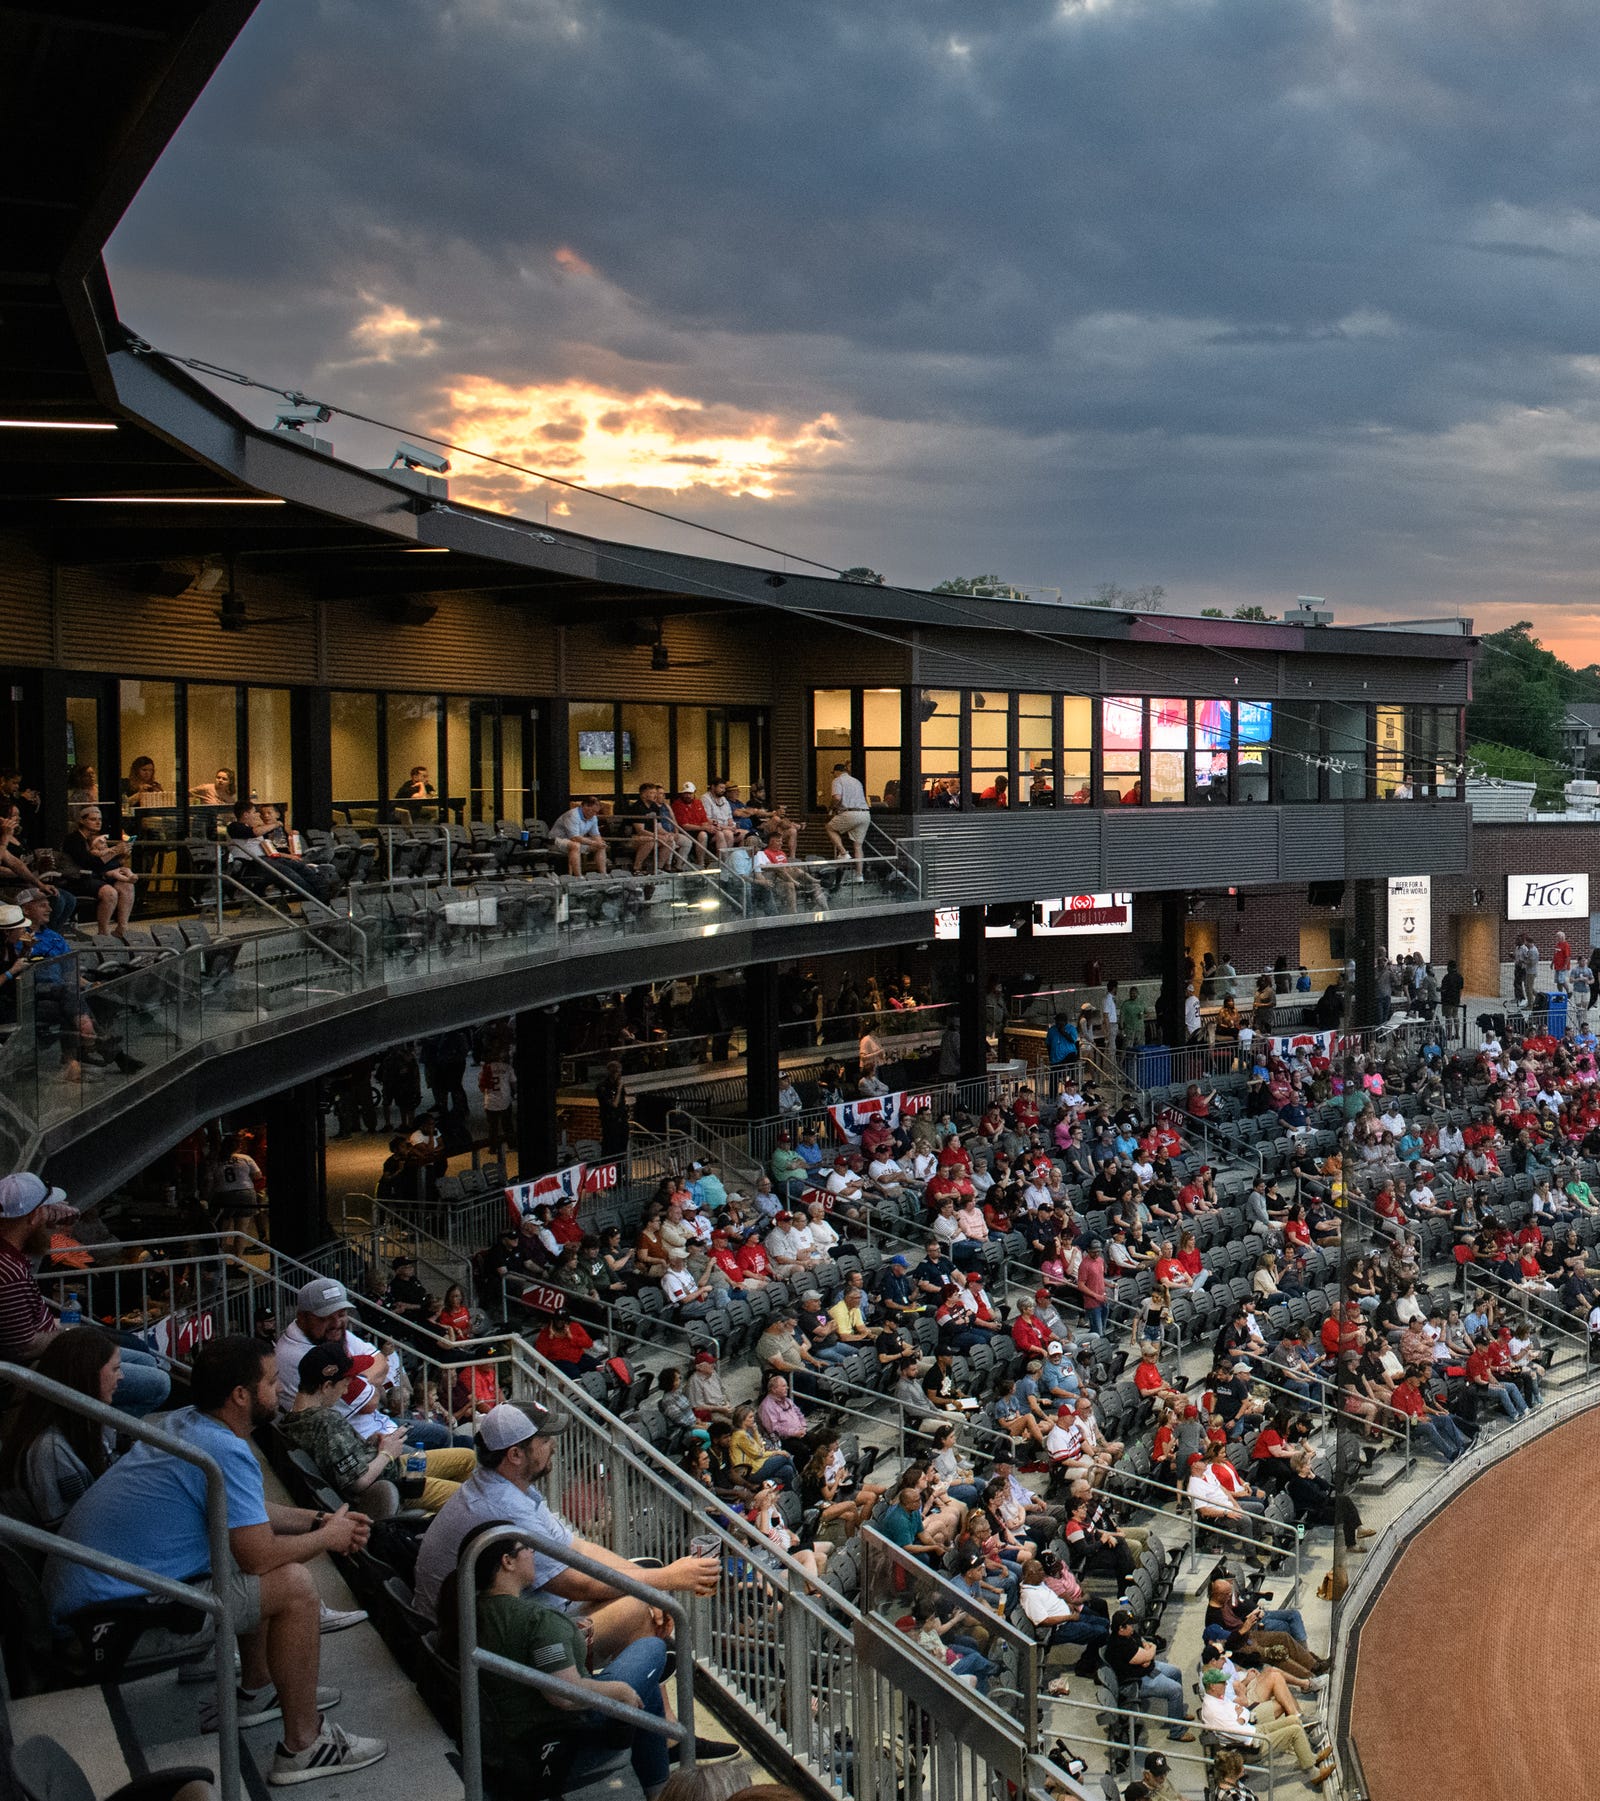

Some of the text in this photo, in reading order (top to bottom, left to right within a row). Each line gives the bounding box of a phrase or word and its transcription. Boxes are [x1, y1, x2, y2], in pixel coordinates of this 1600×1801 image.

[1522, 877, 1574, 907] FTCC
[1169, 1109, 1184, 1125] 118
[594, 1166, 618, 1190] 119
[815, 1190, 835, 1209] 119
[537, 1287, 565, 1310] 120
